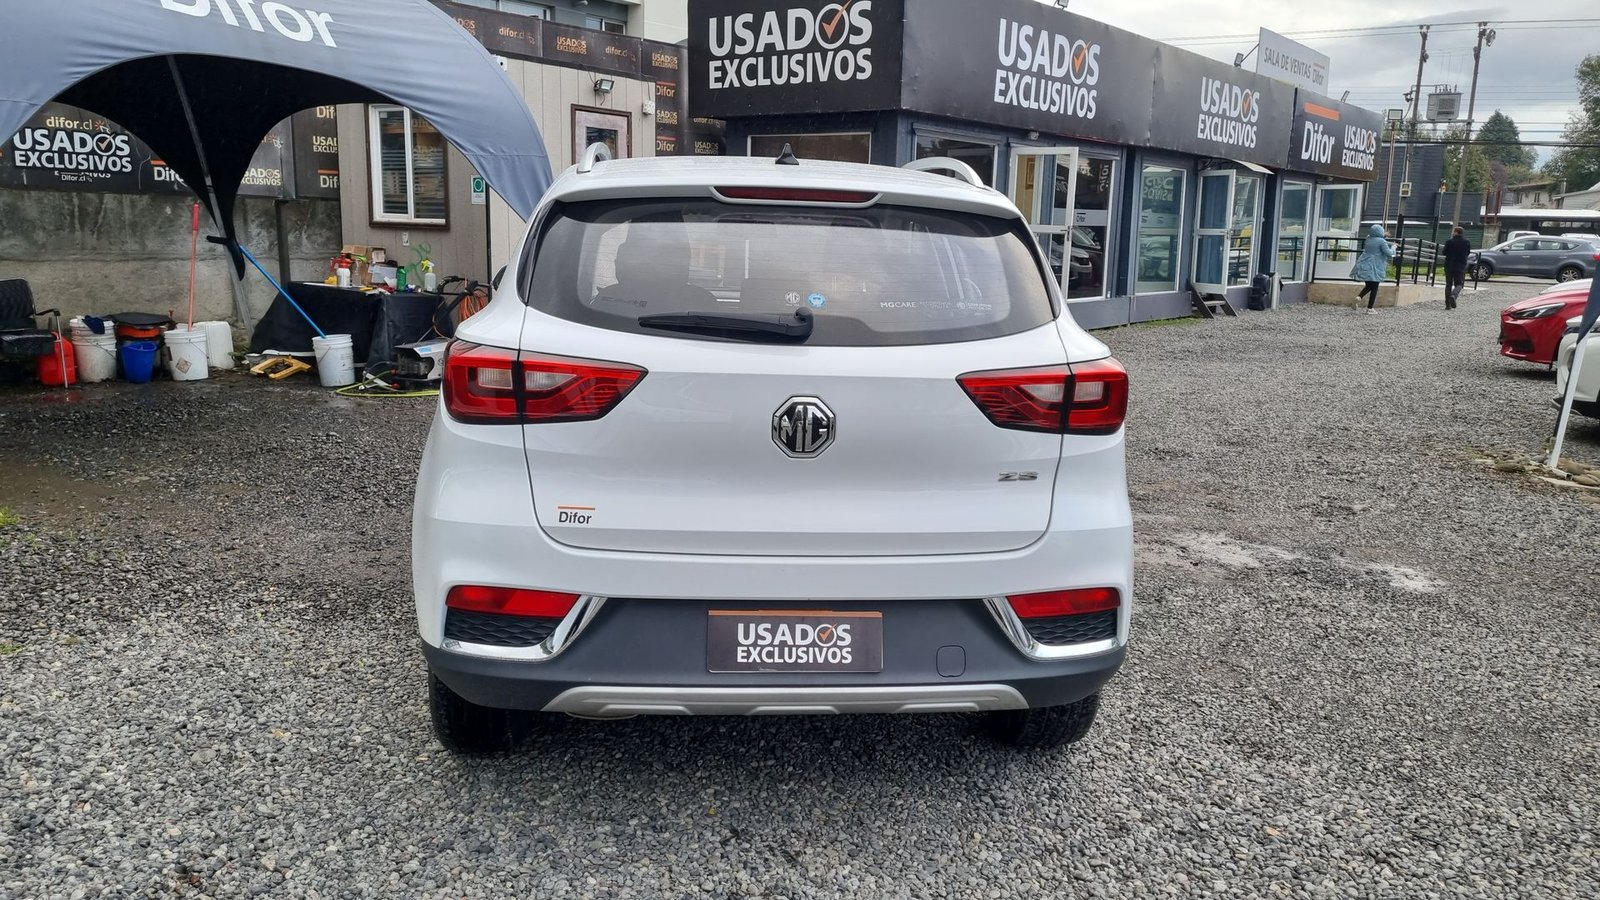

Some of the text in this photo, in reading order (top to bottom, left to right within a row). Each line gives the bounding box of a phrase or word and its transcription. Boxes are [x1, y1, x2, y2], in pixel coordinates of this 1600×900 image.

[708, 0, 873, 57] USADOS
[557, 36, 587, 49] USADOS
[999, 18, 1100, 86] USADOS
[652, 52, 678, 64] USADOS
[708, 47, 873, 89] EXCLUSIVOS
[1263, 47, 1325, 86] SALA DE VENTAS Difor
[993, 69, 1098, 120] EXCLUSIVOS
[1200, 76, 1260, 123] USADOS
[46, 116, 93, 130] difor.cl
[316, 105, 336, 119] Dif
[656, 109, 678, 120] SADOS
[13, 128, 130, 156] USADOS
[313, 135, 337, 146] USA
[1197, 113, 1258, 149] EXCLUSIVOS
[1301, 120, 1336, 164] Difor
[1344, 124, 1377, 153] USADOS
[14, 150, 133, 173] EXCLUSIVOS
[1342, 149, 1375, 171] EXCLUSIVOS
[241, 177, 281, 186] XCLUSIVOS
[320, 175, 339, 188] Dif
[777, 401, 832, 455] MG
[997, 471, 1039, 482] ZS
[558, 511, 592, 524] Difor
[737, 622, 852, 647] USADOS
[736, 646, 853, 664] EXCLUSIVOS
